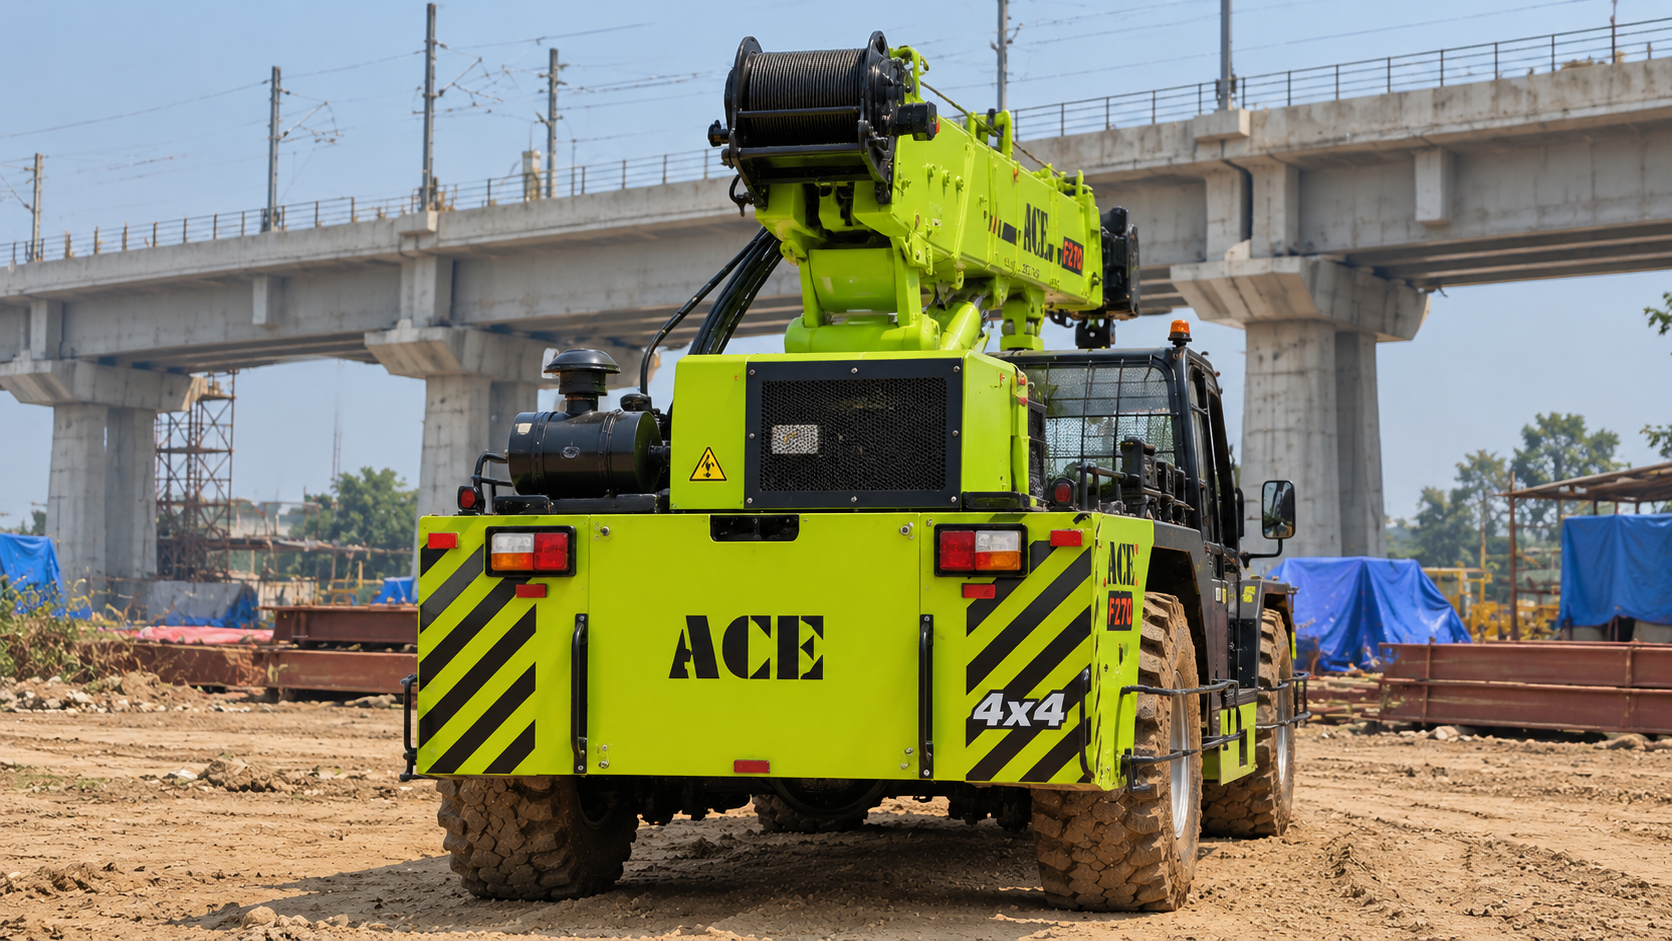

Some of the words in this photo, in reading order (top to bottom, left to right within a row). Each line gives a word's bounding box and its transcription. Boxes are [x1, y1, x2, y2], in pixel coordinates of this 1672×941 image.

[1023, 203, 1049, 261] ACE
[1062, 240, 1083, 271] F270
[1107, 541, 1135, 586] ACE
[1108, 597, 1132, 626] F270
[668, 614, 824, 680] ACE
[972, 692, 1066, 727] 4x4
